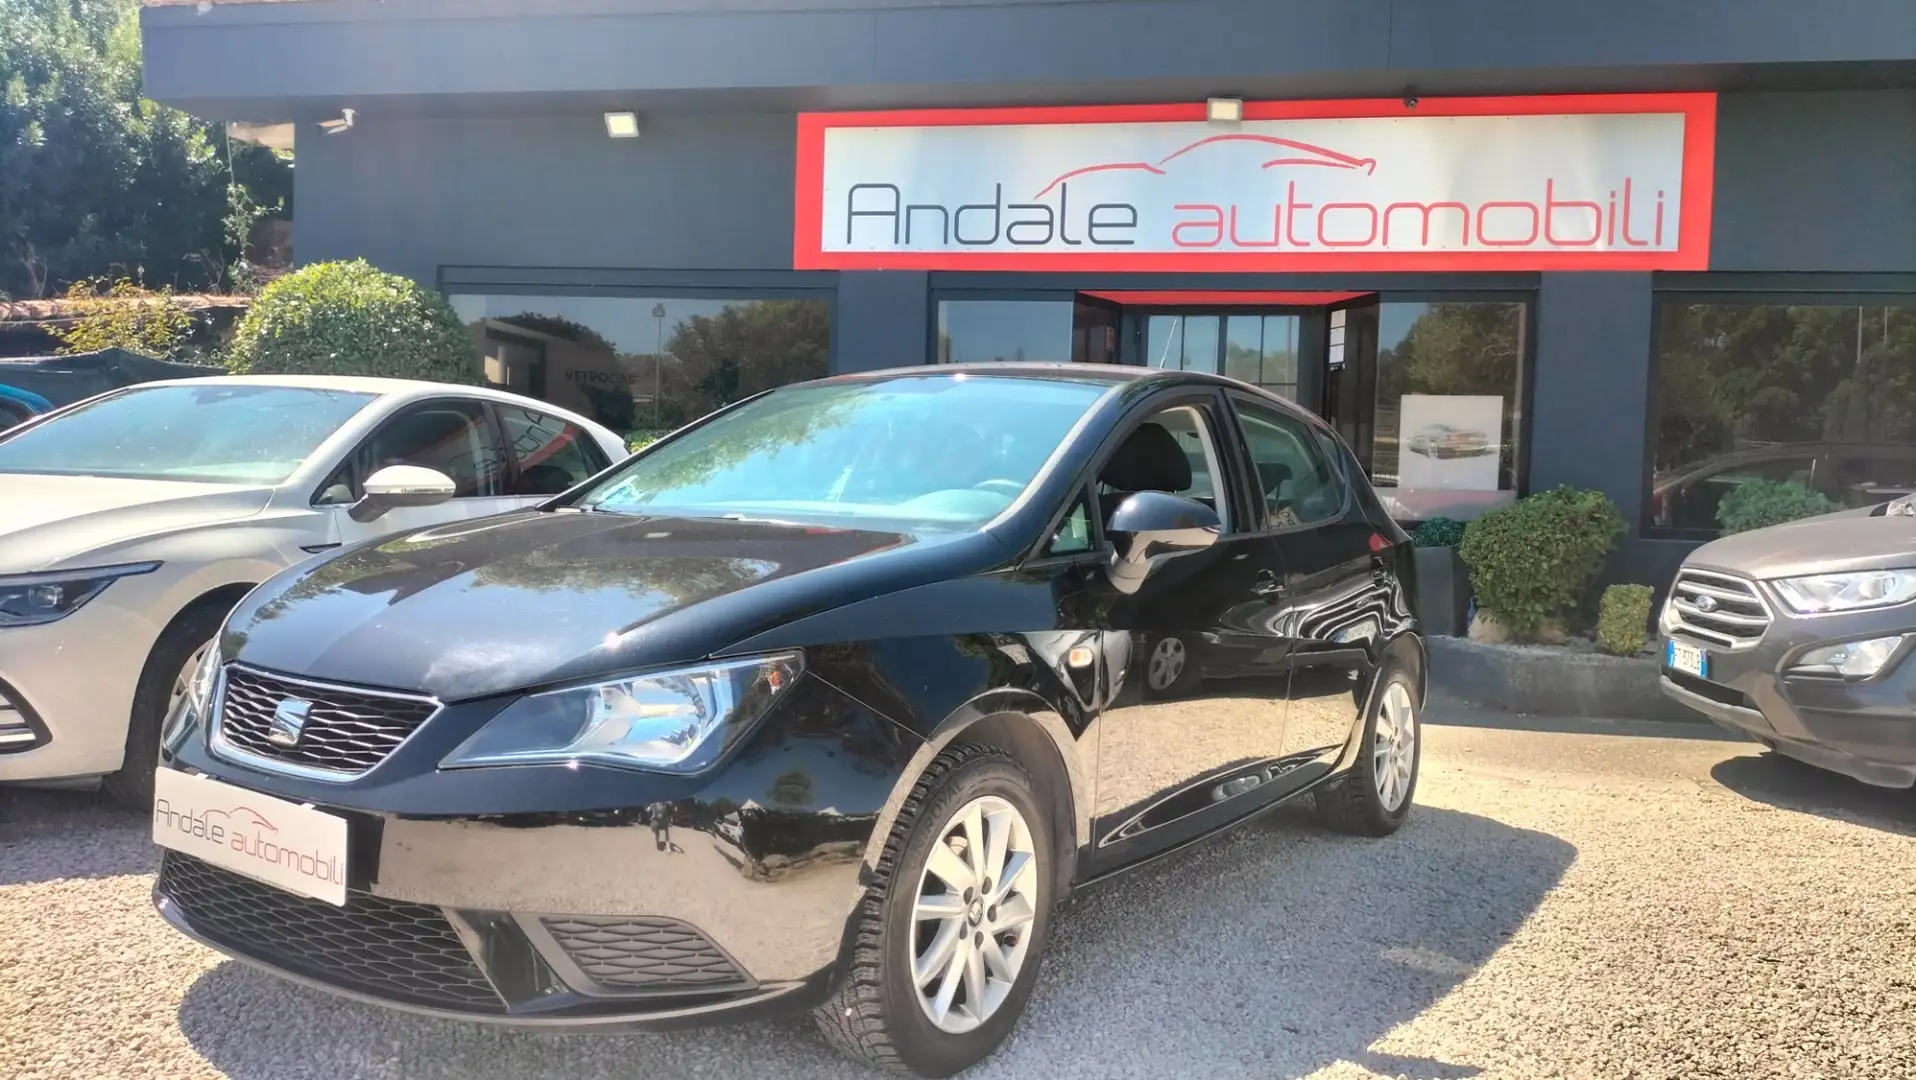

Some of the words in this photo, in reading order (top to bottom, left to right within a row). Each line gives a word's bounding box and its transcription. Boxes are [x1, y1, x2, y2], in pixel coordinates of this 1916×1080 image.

[847, 182, 1138, 245] Andale
[1171, 177, 1665, 247] automobili
[156, 798, 225, 845] Andale
[230, 830, 344, 886] automobili
